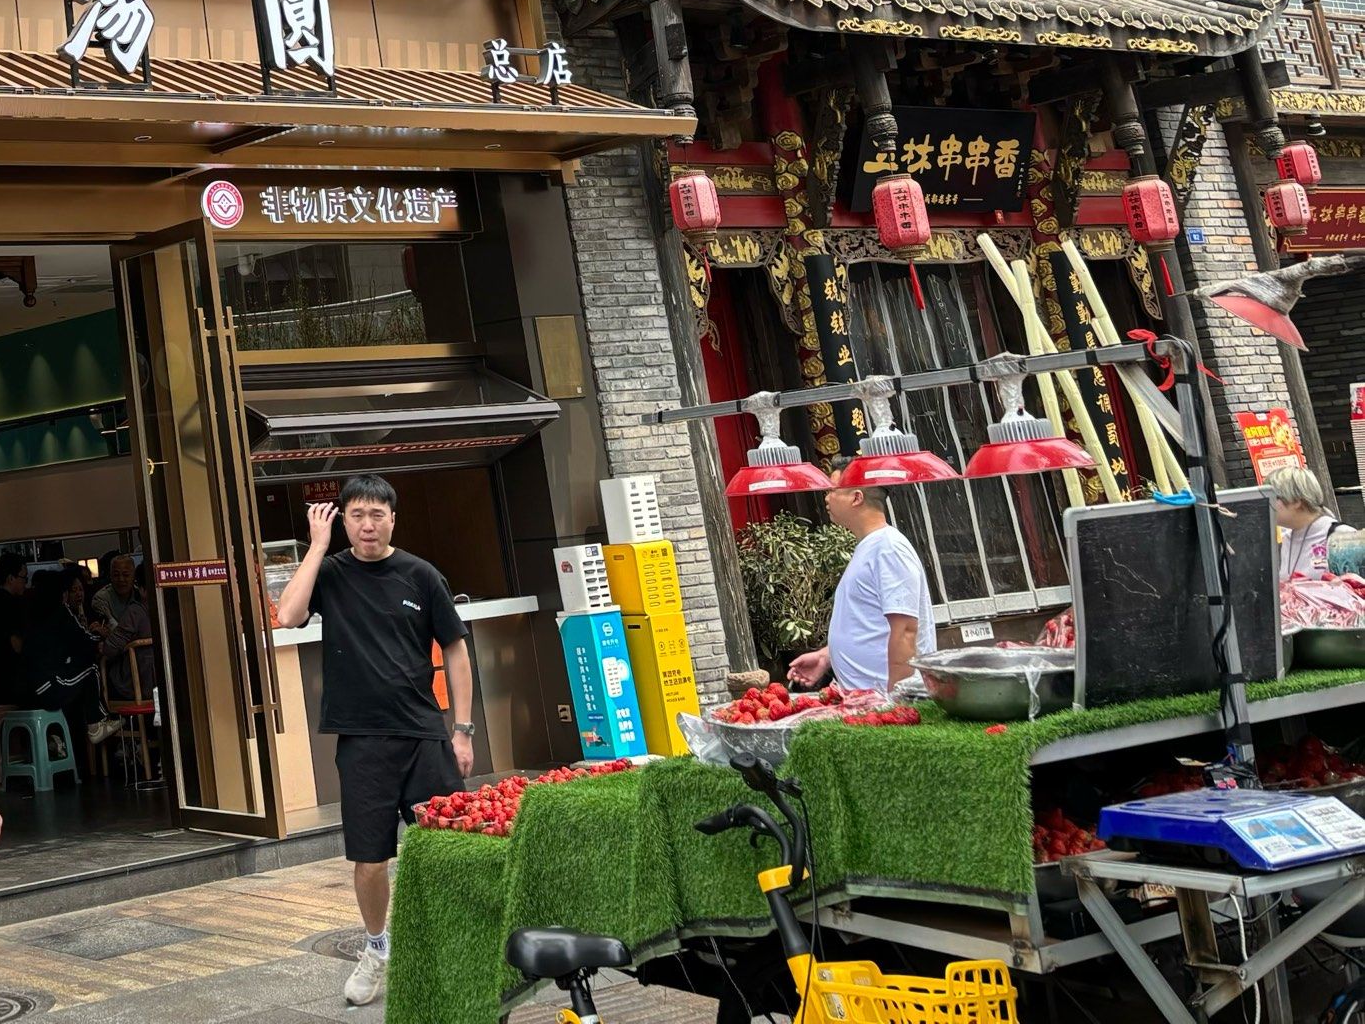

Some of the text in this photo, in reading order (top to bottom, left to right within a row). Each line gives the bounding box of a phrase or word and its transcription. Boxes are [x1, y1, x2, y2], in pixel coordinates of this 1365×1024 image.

[483, 39, 573, 86] 总店
[259, 185, 459, 224] 非物质文化遗产
